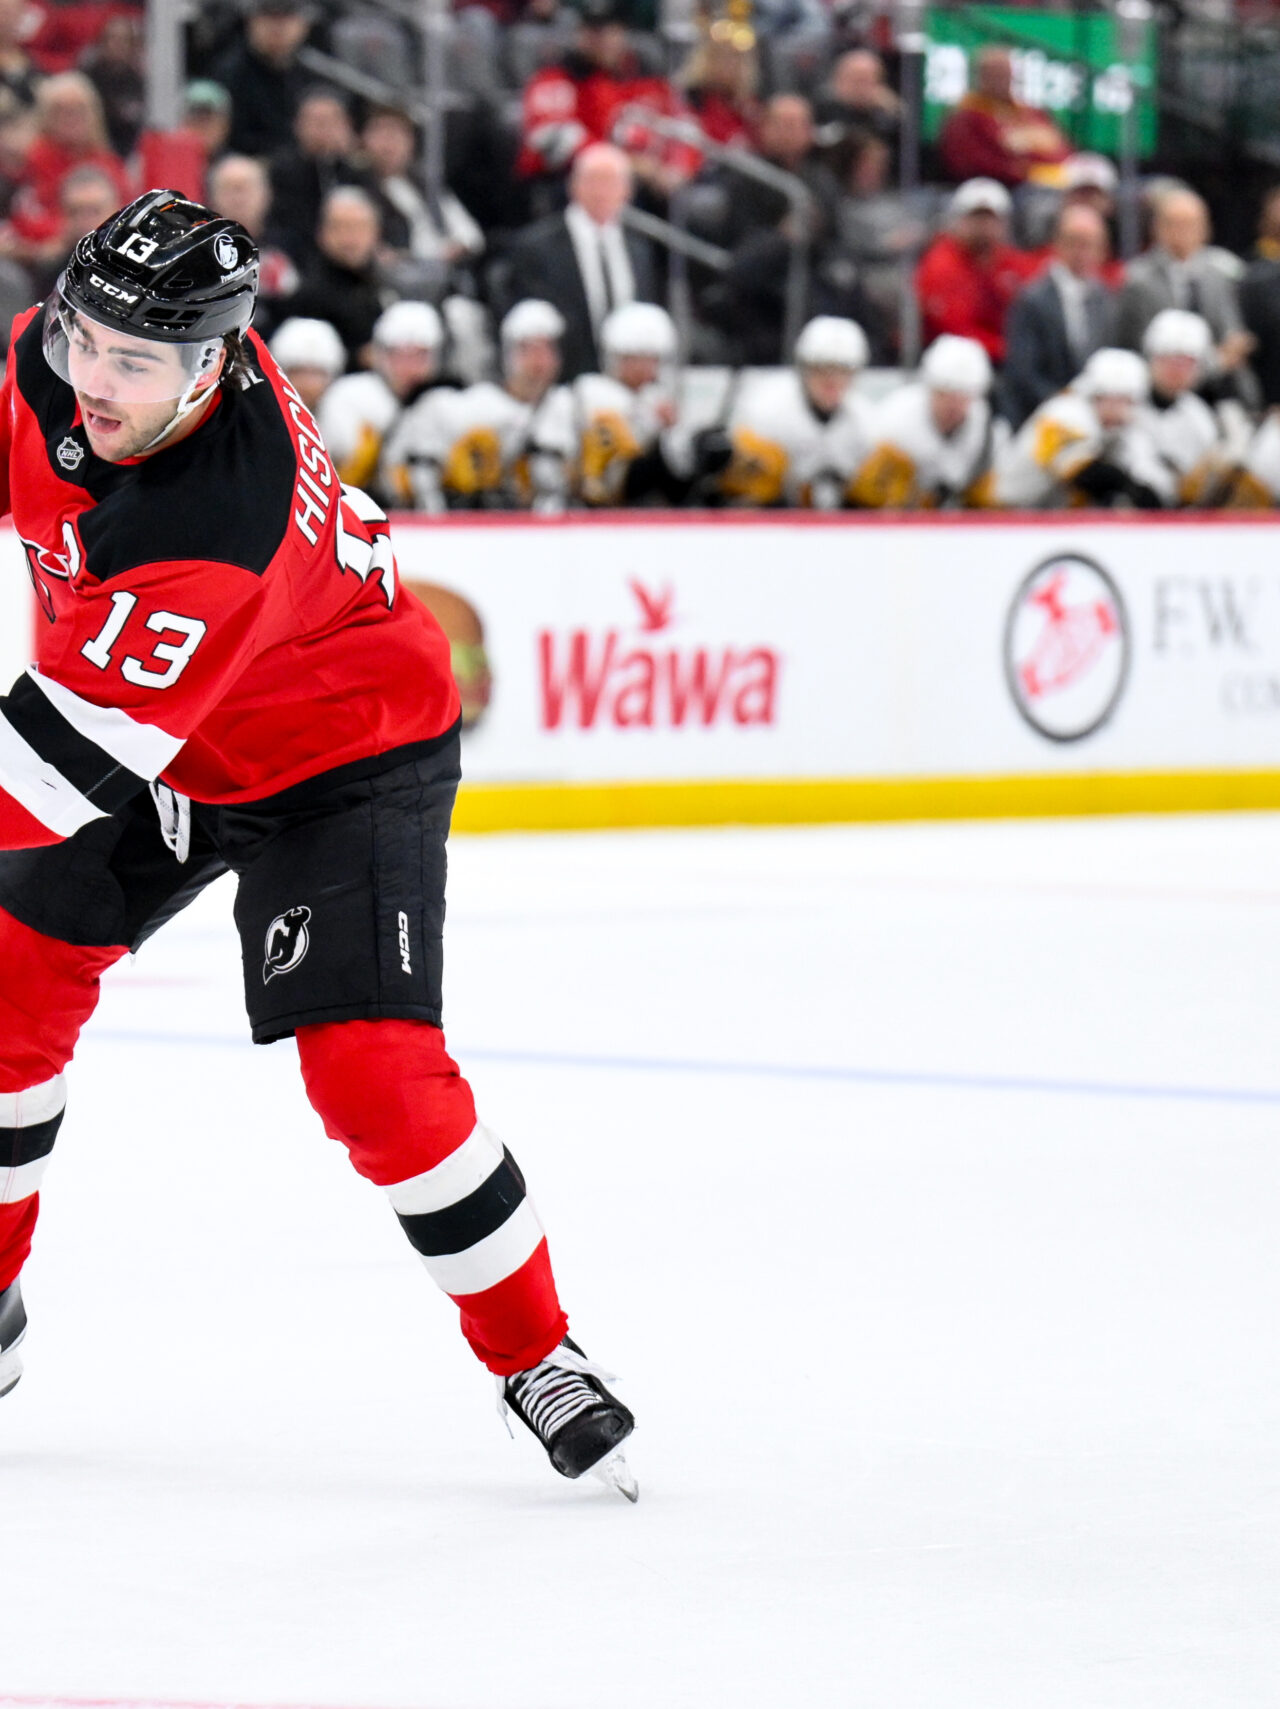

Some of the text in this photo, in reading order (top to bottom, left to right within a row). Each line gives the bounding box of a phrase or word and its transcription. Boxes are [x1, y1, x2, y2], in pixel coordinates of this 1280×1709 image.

[117, 233, 159, 263] 13
[90, 273, 139, 304] CCM
[61, 450, 79, 458] NHL
[80, 590, 208, 690] 13
[537, 627, 782, 732] Wawa
[397, 910, 413, 975] CCM
